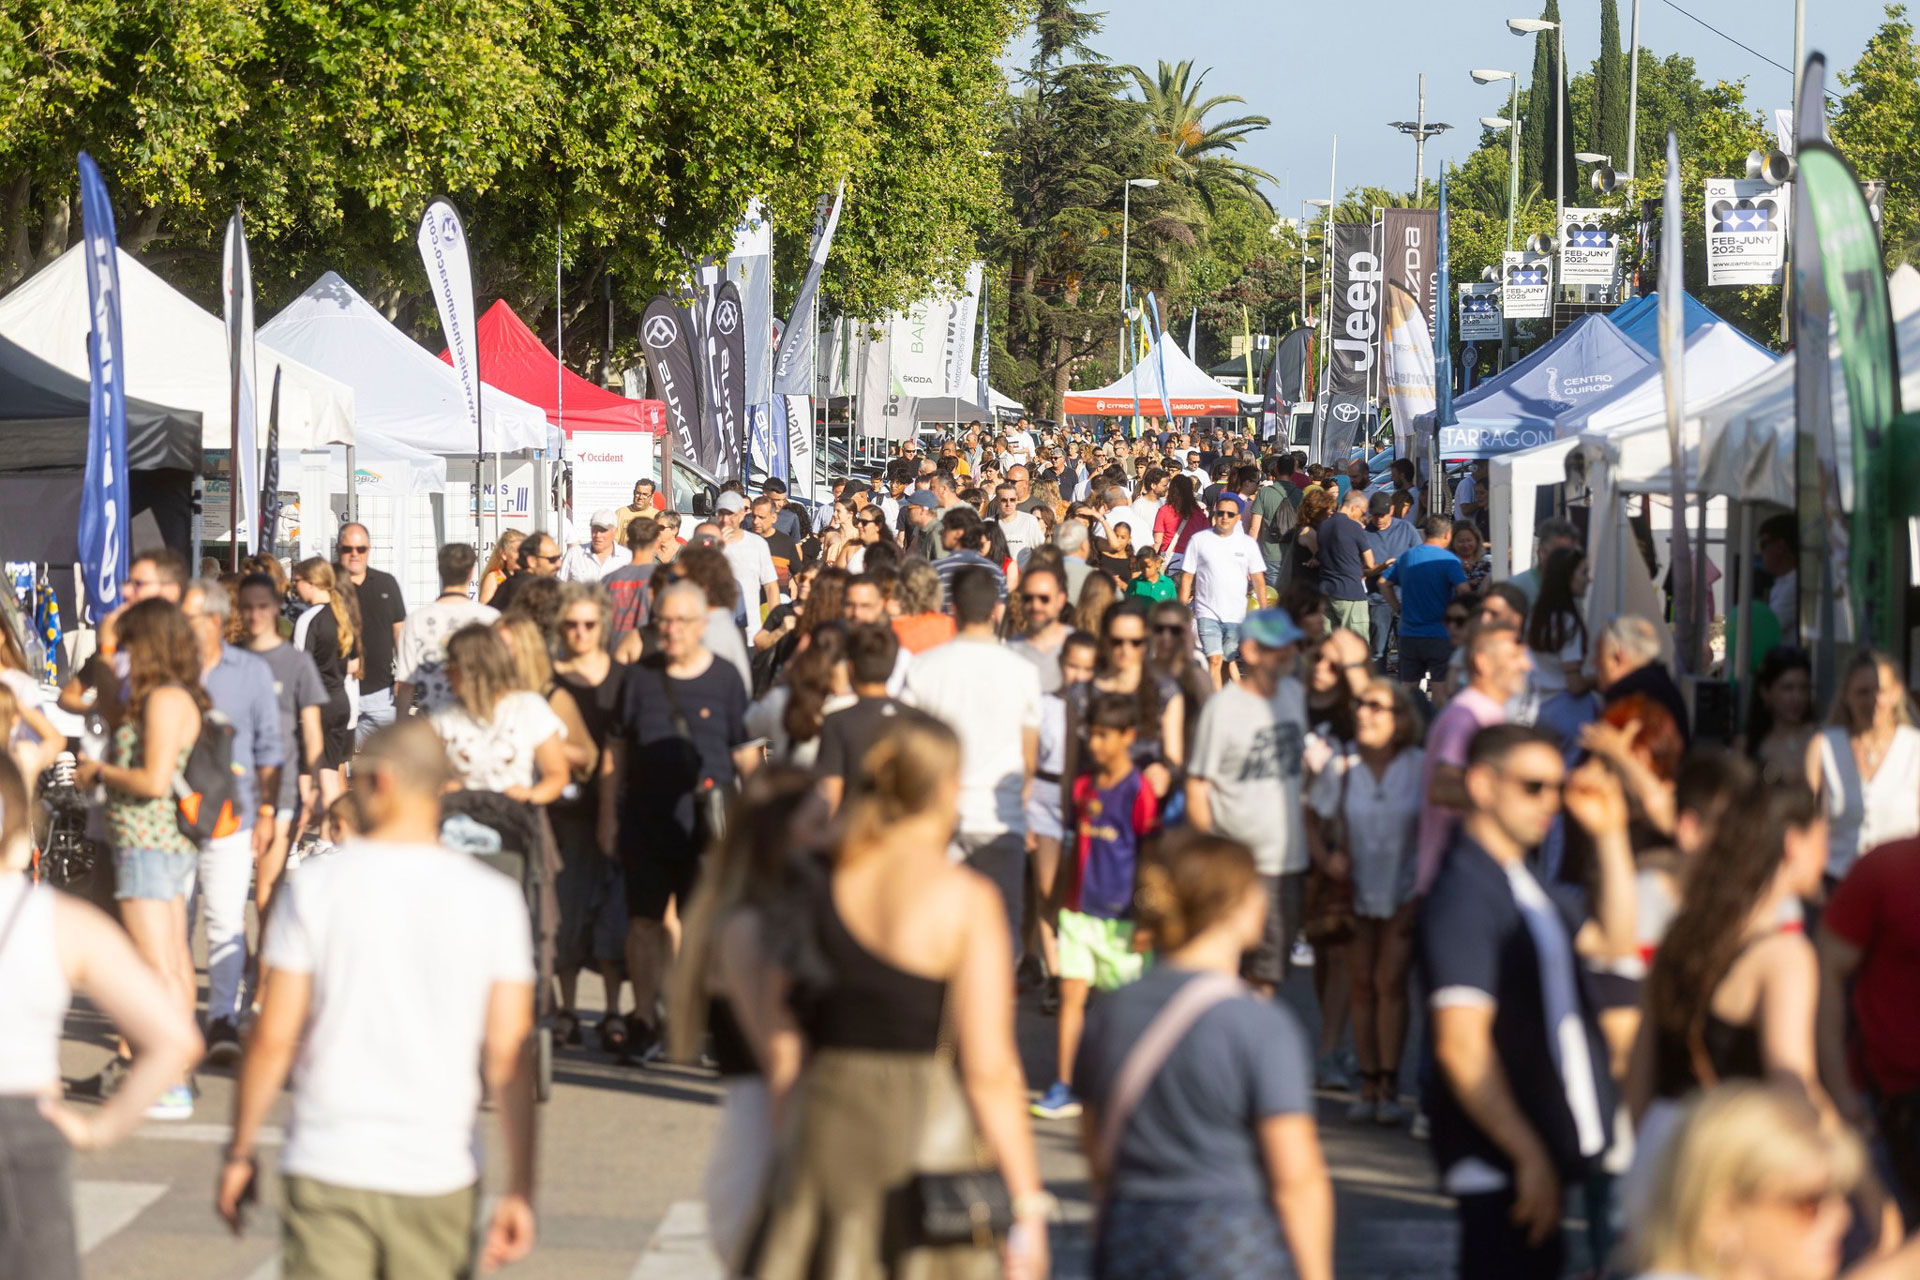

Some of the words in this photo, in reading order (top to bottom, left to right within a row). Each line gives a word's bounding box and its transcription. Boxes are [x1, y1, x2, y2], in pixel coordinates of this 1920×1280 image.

[1711, 236, 1773, 246] FEB-JUNY
[1712, 246, 1744, 254] 2025
[1334, 251, 1383, 372] Jeep
[1563, 375, 1612, 386] CENTRO
[587, 453, 624, 462] Occident
